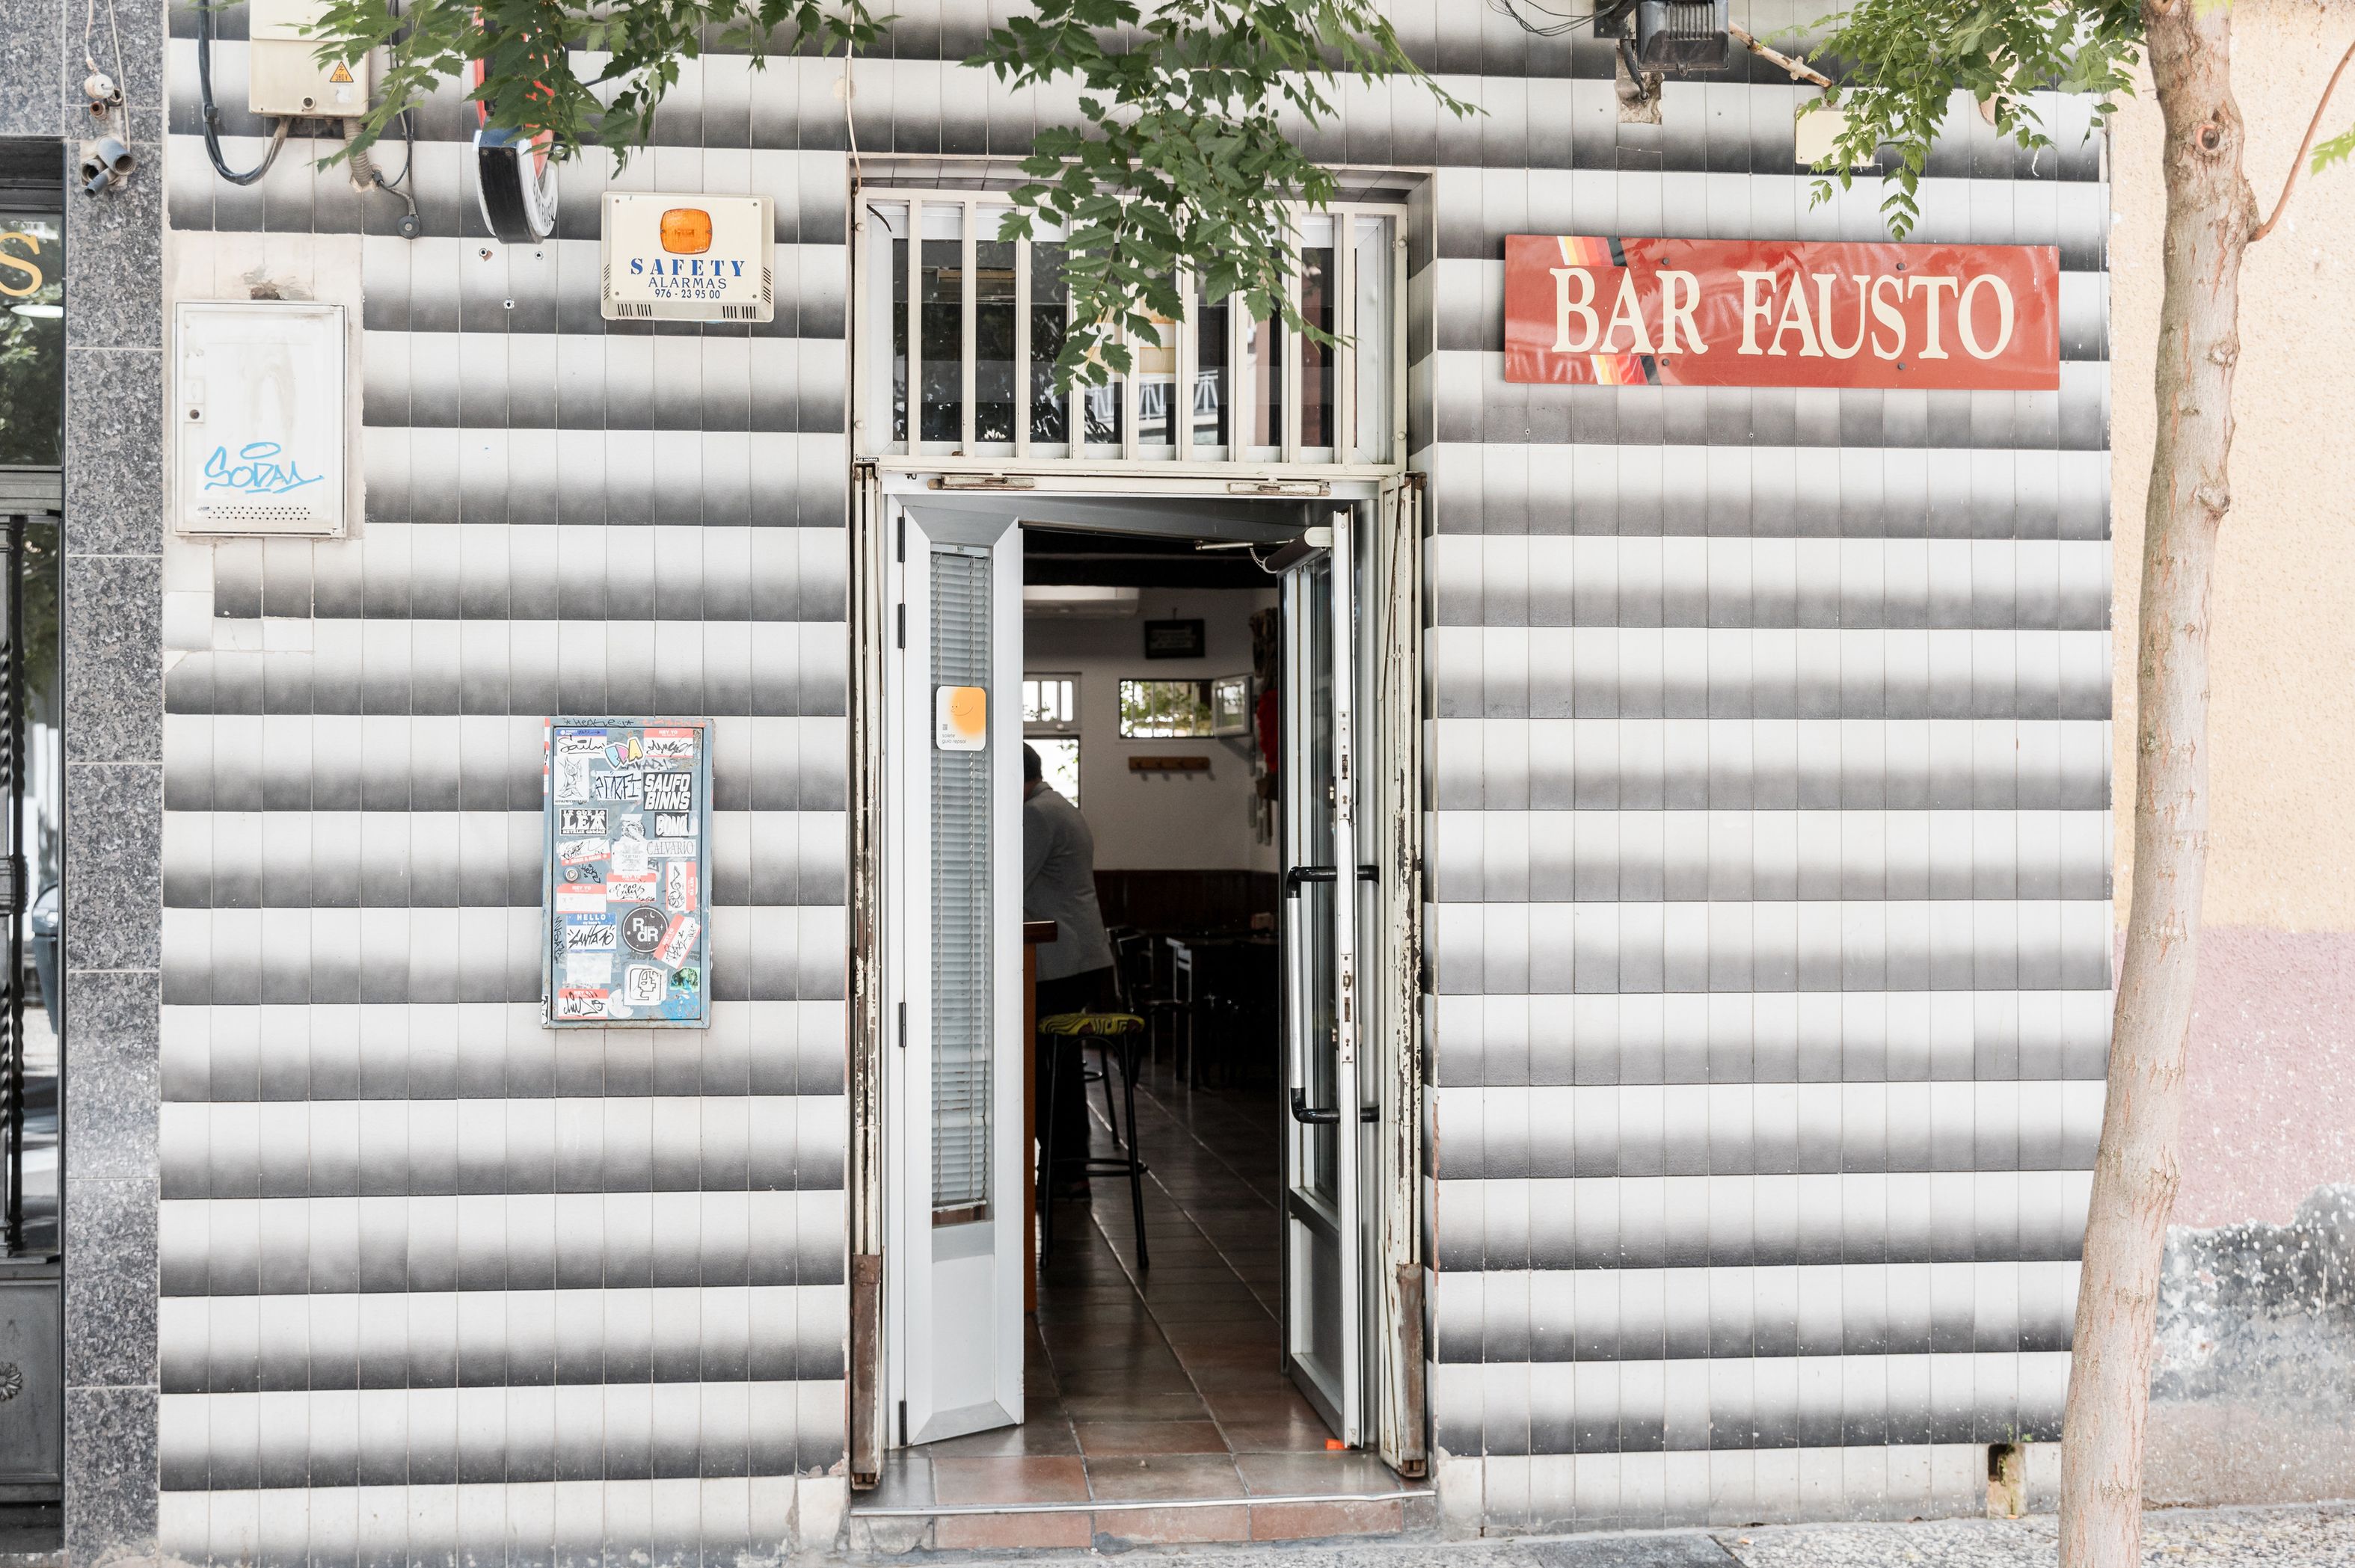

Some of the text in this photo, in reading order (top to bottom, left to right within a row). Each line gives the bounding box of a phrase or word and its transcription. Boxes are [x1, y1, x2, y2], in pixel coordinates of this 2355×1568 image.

[630, 258, 745, 277] SAFETY
[648, 277, 727, 289] ALARMAS
[655, 289, 672, 298] 976
[681, 289, 692, 298] 23
[695, 289, 706, 298] 95
[709, 290, 720, 299] 00
[1549, 267, 2015, 360] BAR FAUSTO
[645, 774, 690, 792] SAUFO
[644, 792, 691, 810] BINNS
[562, 814, 606, 830] LEA
[647, 840, 694, 855] CALVARIO
